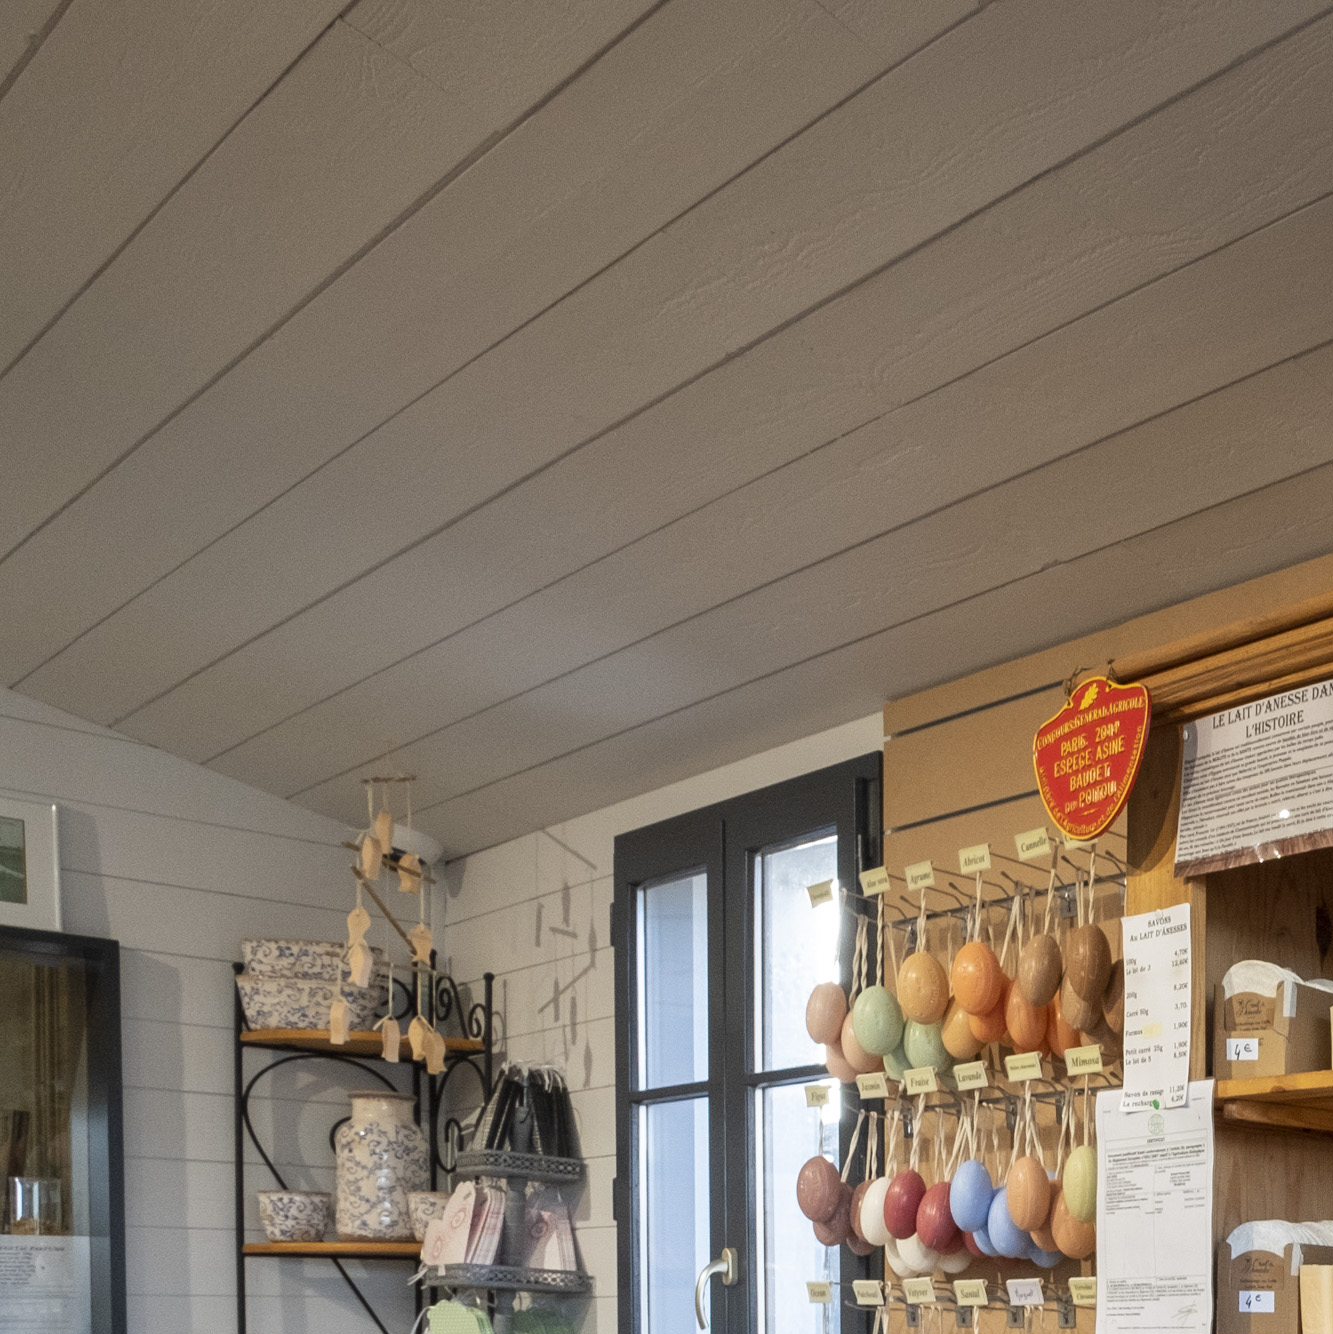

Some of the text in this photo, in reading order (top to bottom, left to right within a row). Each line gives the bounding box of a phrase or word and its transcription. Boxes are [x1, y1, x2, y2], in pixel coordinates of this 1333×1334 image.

[1212, 714, 1225, 729] LE
[1228, 705, 1253, 723] LAIT
[1255, 690, 1308, 716] D'ANESSE
[1245, 710, 1304, 738] L'HISTOIRE
[1096, 735, 1125, 761] ASINE
[1139, 930, 1154, 940] LAIT
[1071, 1055, 1100, 1068] Mimosa
